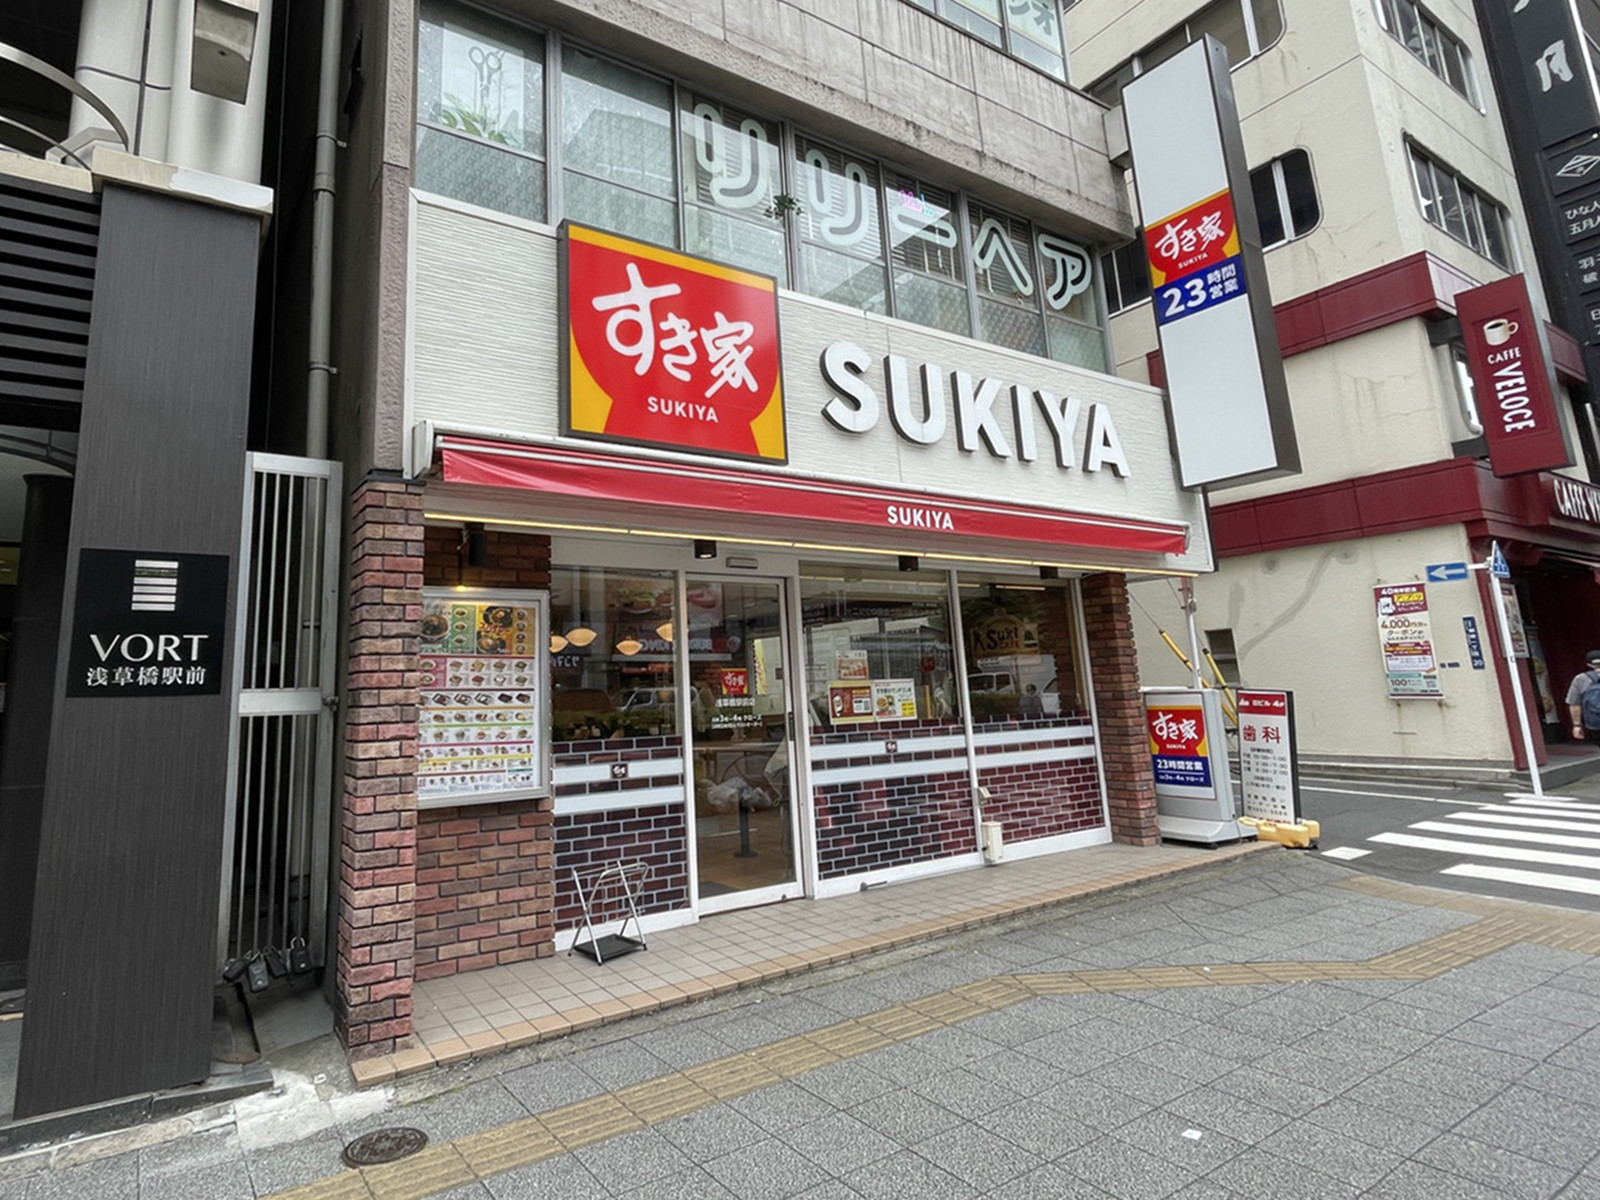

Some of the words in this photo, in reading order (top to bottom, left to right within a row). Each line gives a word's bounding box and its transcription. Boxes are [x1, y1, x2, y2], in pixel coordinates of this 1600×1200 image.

[1154, 211, 1225, 260] すき家
[1178, 252, 1208, 269] SUKIYA
[1207, 263, 1237, 285] 時間
[1162, 278, 1207, 317] 23
[1209, 277, 1239, 300] 営業
[592, 262, 759, 399] すき家
[1487, 347, 1521, 365] CAFFE
[647, 396, 719, 424] SUKIYA
[819, 341, 1131, 478] SUKIYA
[1492, 361, 1536, 433] VELOCE
[1553, 479, 1590, 521] CAFFE
[887, 506, 954, 531] SUKIYA
[89, 633, 209, 662] VORT
[86, 665, 206, 686] 浅草橋駅前
[1152, 711, 1199, 744] すき家
[1156, 759, 1204, 771] 23時間営業
